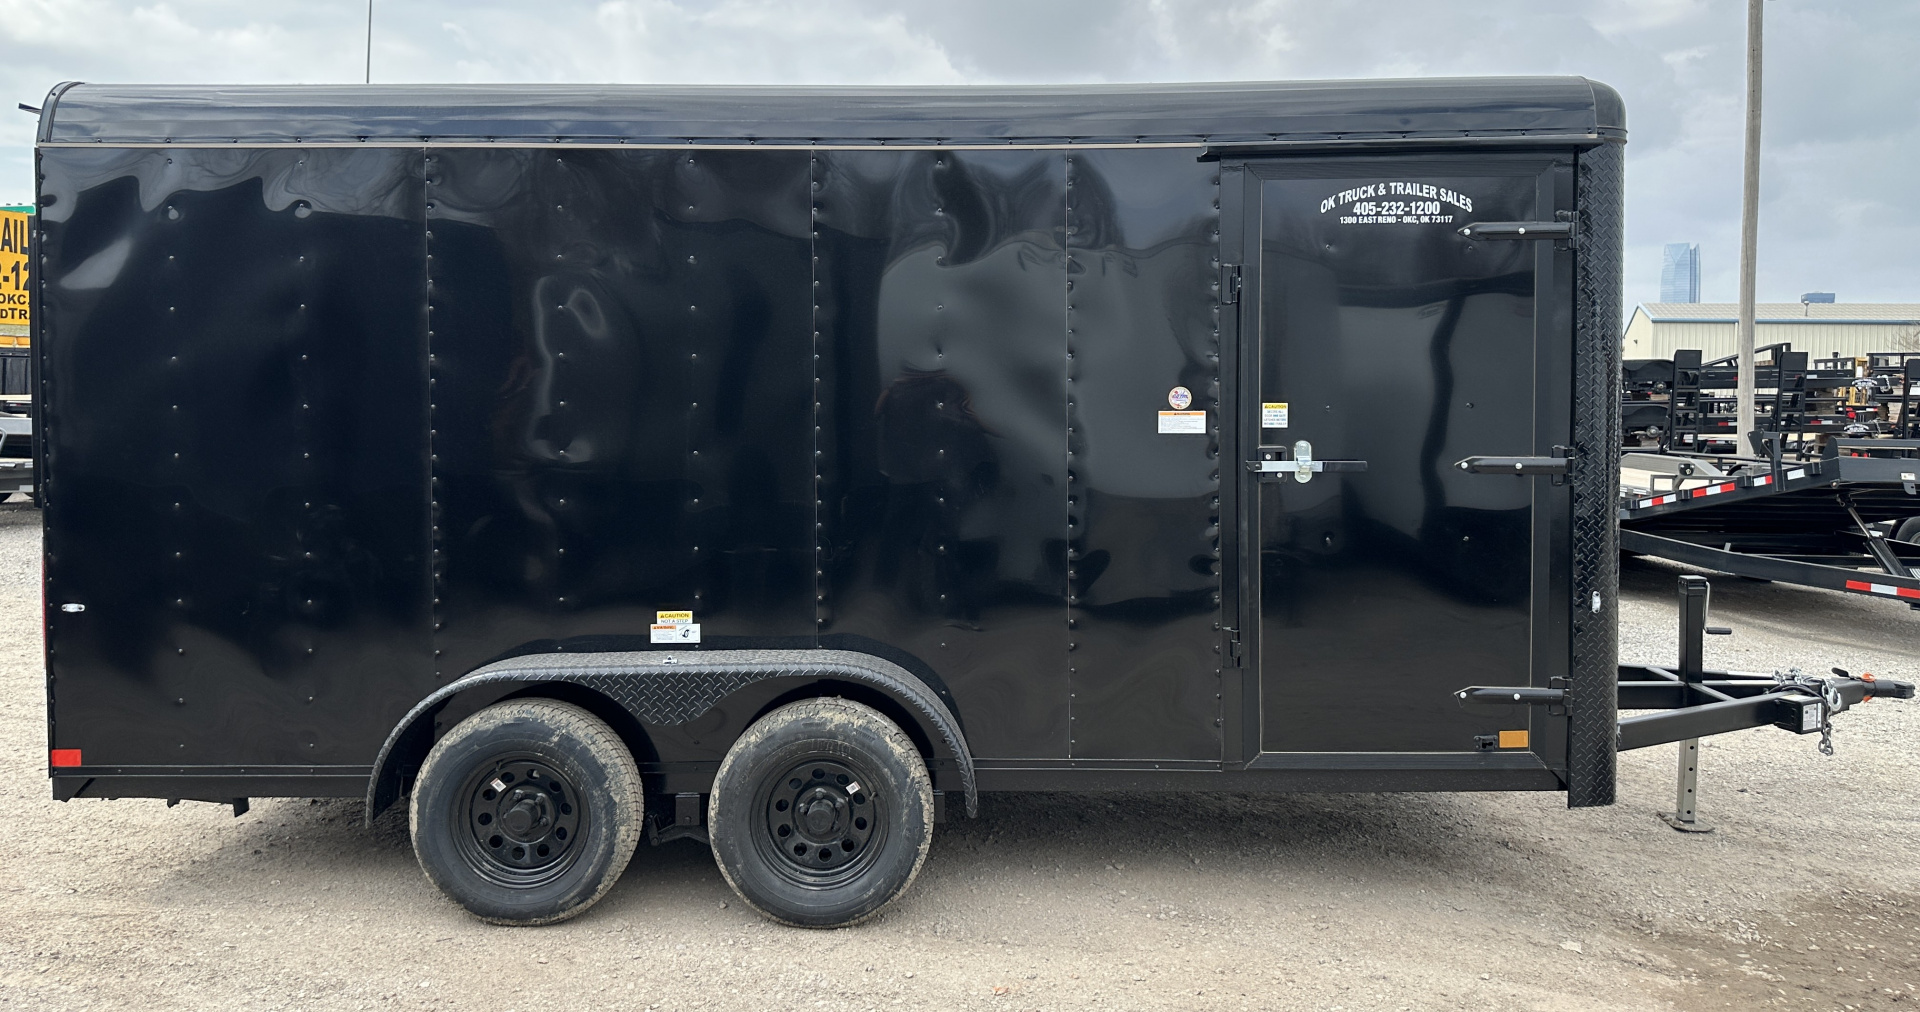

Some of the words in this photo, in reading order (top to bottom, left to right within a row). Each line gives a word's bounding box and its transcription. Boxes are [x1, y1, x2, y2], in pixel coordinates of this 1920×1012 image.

[1320, 195, 1335, 214] OK
[1338, 184, 1376, 206] TRUCK
[1378, 183, 1386, 196] &
[1389, 182, 1437, 199] TRAILER
[1440, 188, 1473, 213] SALES
[1352, 201, 1441, 216] 405-232-1200
[1339, 216, 1358, 224] 1300
[1358, 216, 1378, 224] EAST
[1377, 216, 1396, 224] RENO
[1402, 216, 1419, 225] OKC,
[1420, 216, 1431, 224] OK
[1431, 215, 1453, 224] 73117
